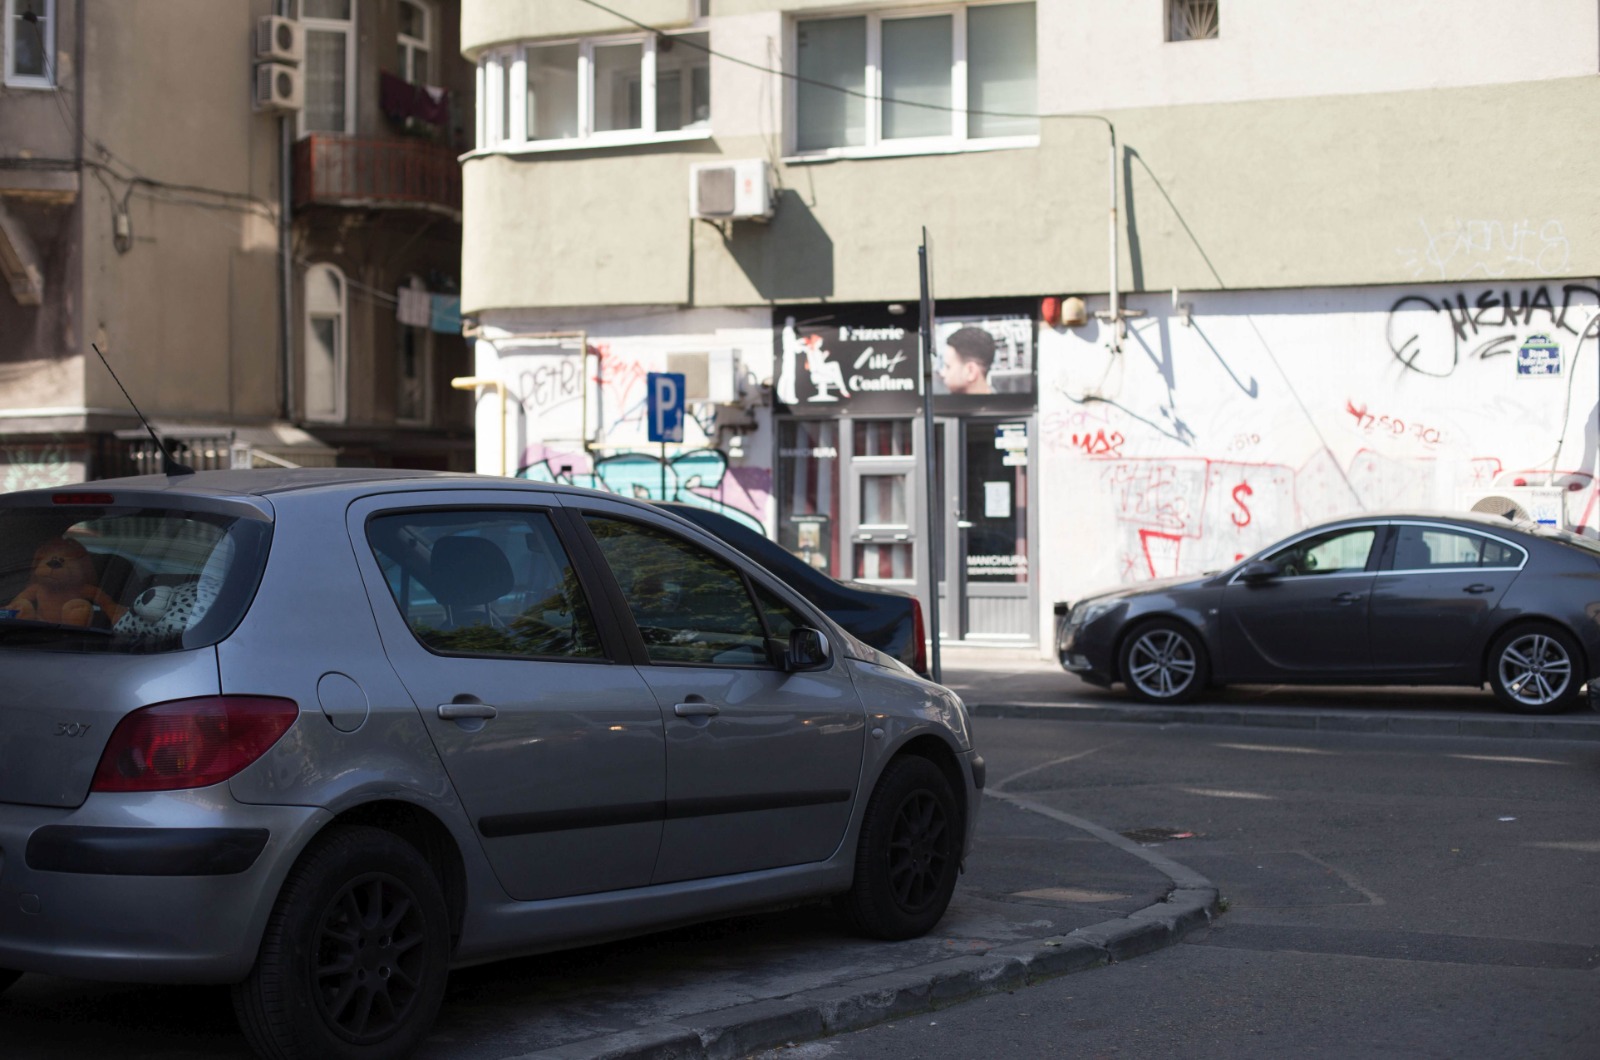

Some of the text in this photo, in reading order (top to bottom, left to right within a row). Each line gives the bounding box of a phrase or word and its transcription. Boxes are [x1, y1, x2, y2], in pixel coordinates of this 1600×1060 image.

[849, 374, 914, 391] Coafura
[655, 377, 677, 435] P
[53, 722, 92, 738] 307
